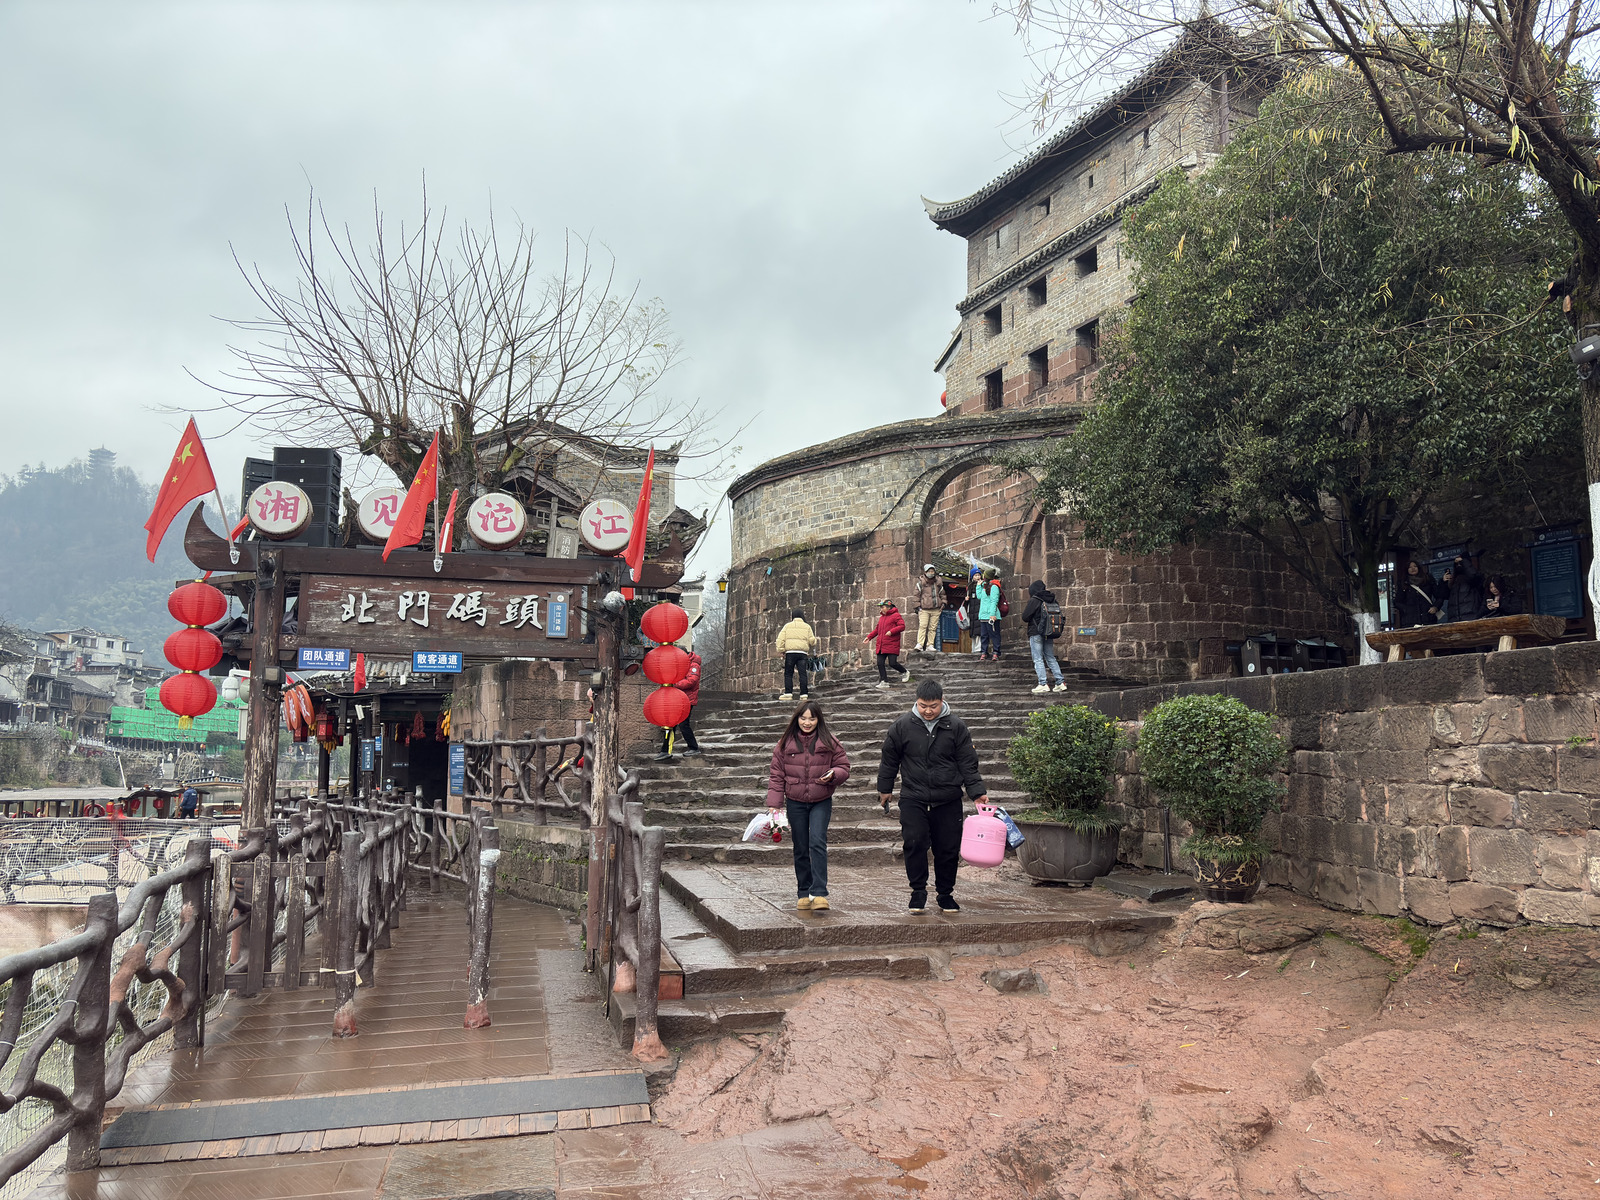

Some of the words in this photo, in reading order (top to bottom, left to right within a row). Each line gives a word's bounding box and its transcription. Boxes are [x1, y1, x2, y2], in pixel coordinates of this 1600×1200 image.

[255, 488, 300, 524] 湘
[370, 494, 398, 527] 见
[477, 499, 516, 533] 沱
[589, 507, 628, 539] 江
[561, 535, 571, 558] 消防
[341, 590, 543, 630] 北門碼頭
[303, 650, 345, 662] 团队通道
[417, 653, 458, 665] 散客通道
